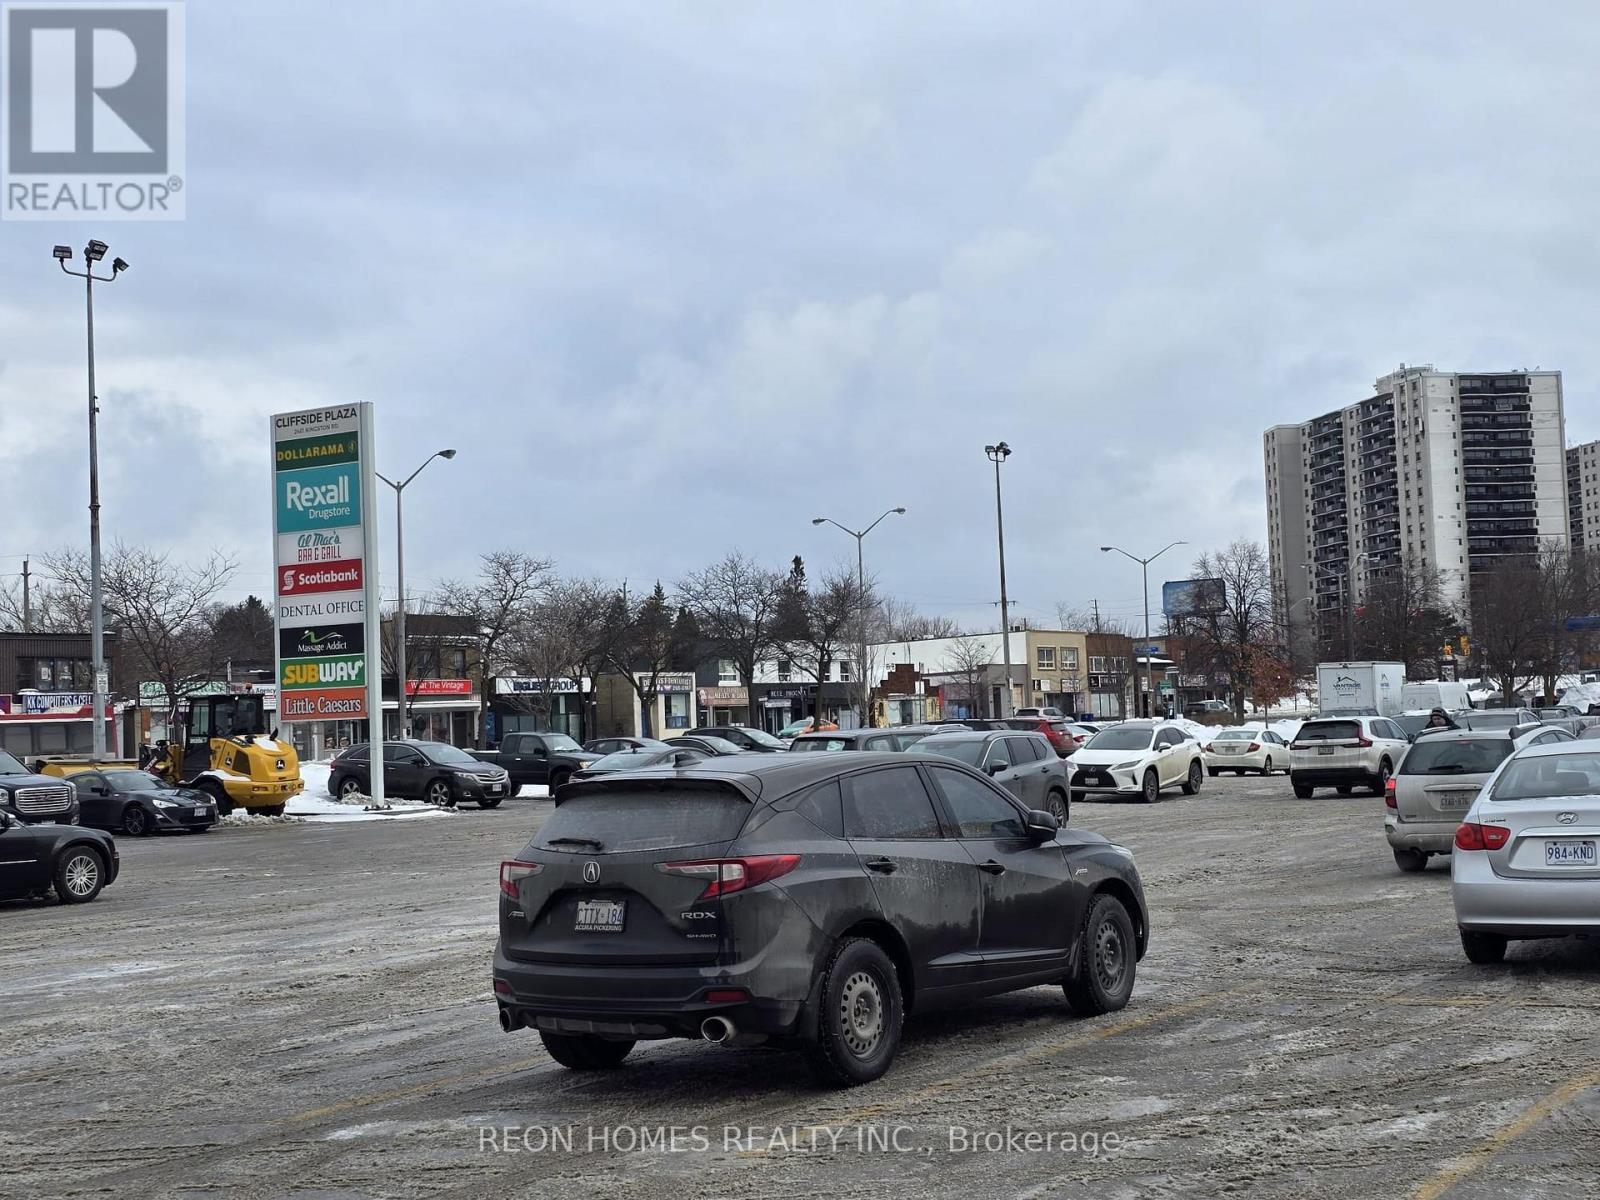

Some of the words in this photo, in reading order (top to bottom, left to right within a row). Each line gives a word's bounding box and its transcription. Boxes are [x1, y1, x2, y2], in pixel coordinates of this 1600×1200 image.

[276, 412, 323, 428] CLIFFSIDE
[325, 408, 357, 421] PLAZA
[277, 443, 344, 461] DOLLARAMA
[286, 475, 350, 511] Rexall
[309, 506, 351, 519] Drugstore
[298, 547, 312, 561] BAR
[299, 568, 358, 585] Scotiabank
[281, 604, 324, 618] DENTAL
[326, 600, 364, 614] OFFICE
[298, 643, 324, 652] Massage
[326, 641, 347, 650] Addict
[282, 660, 364, 685] SUBWAY
[411, 681, 427, 689] Wat
[430, 681, 440, 689] The
[441, 681, 464, 690] Vintage
[36, 695, 72, 709] COMPUTERS
[285, 698, 315, 714] Little
[317, 696, 361, 713] Caesars
[681, 911, 717, 919] RDX
